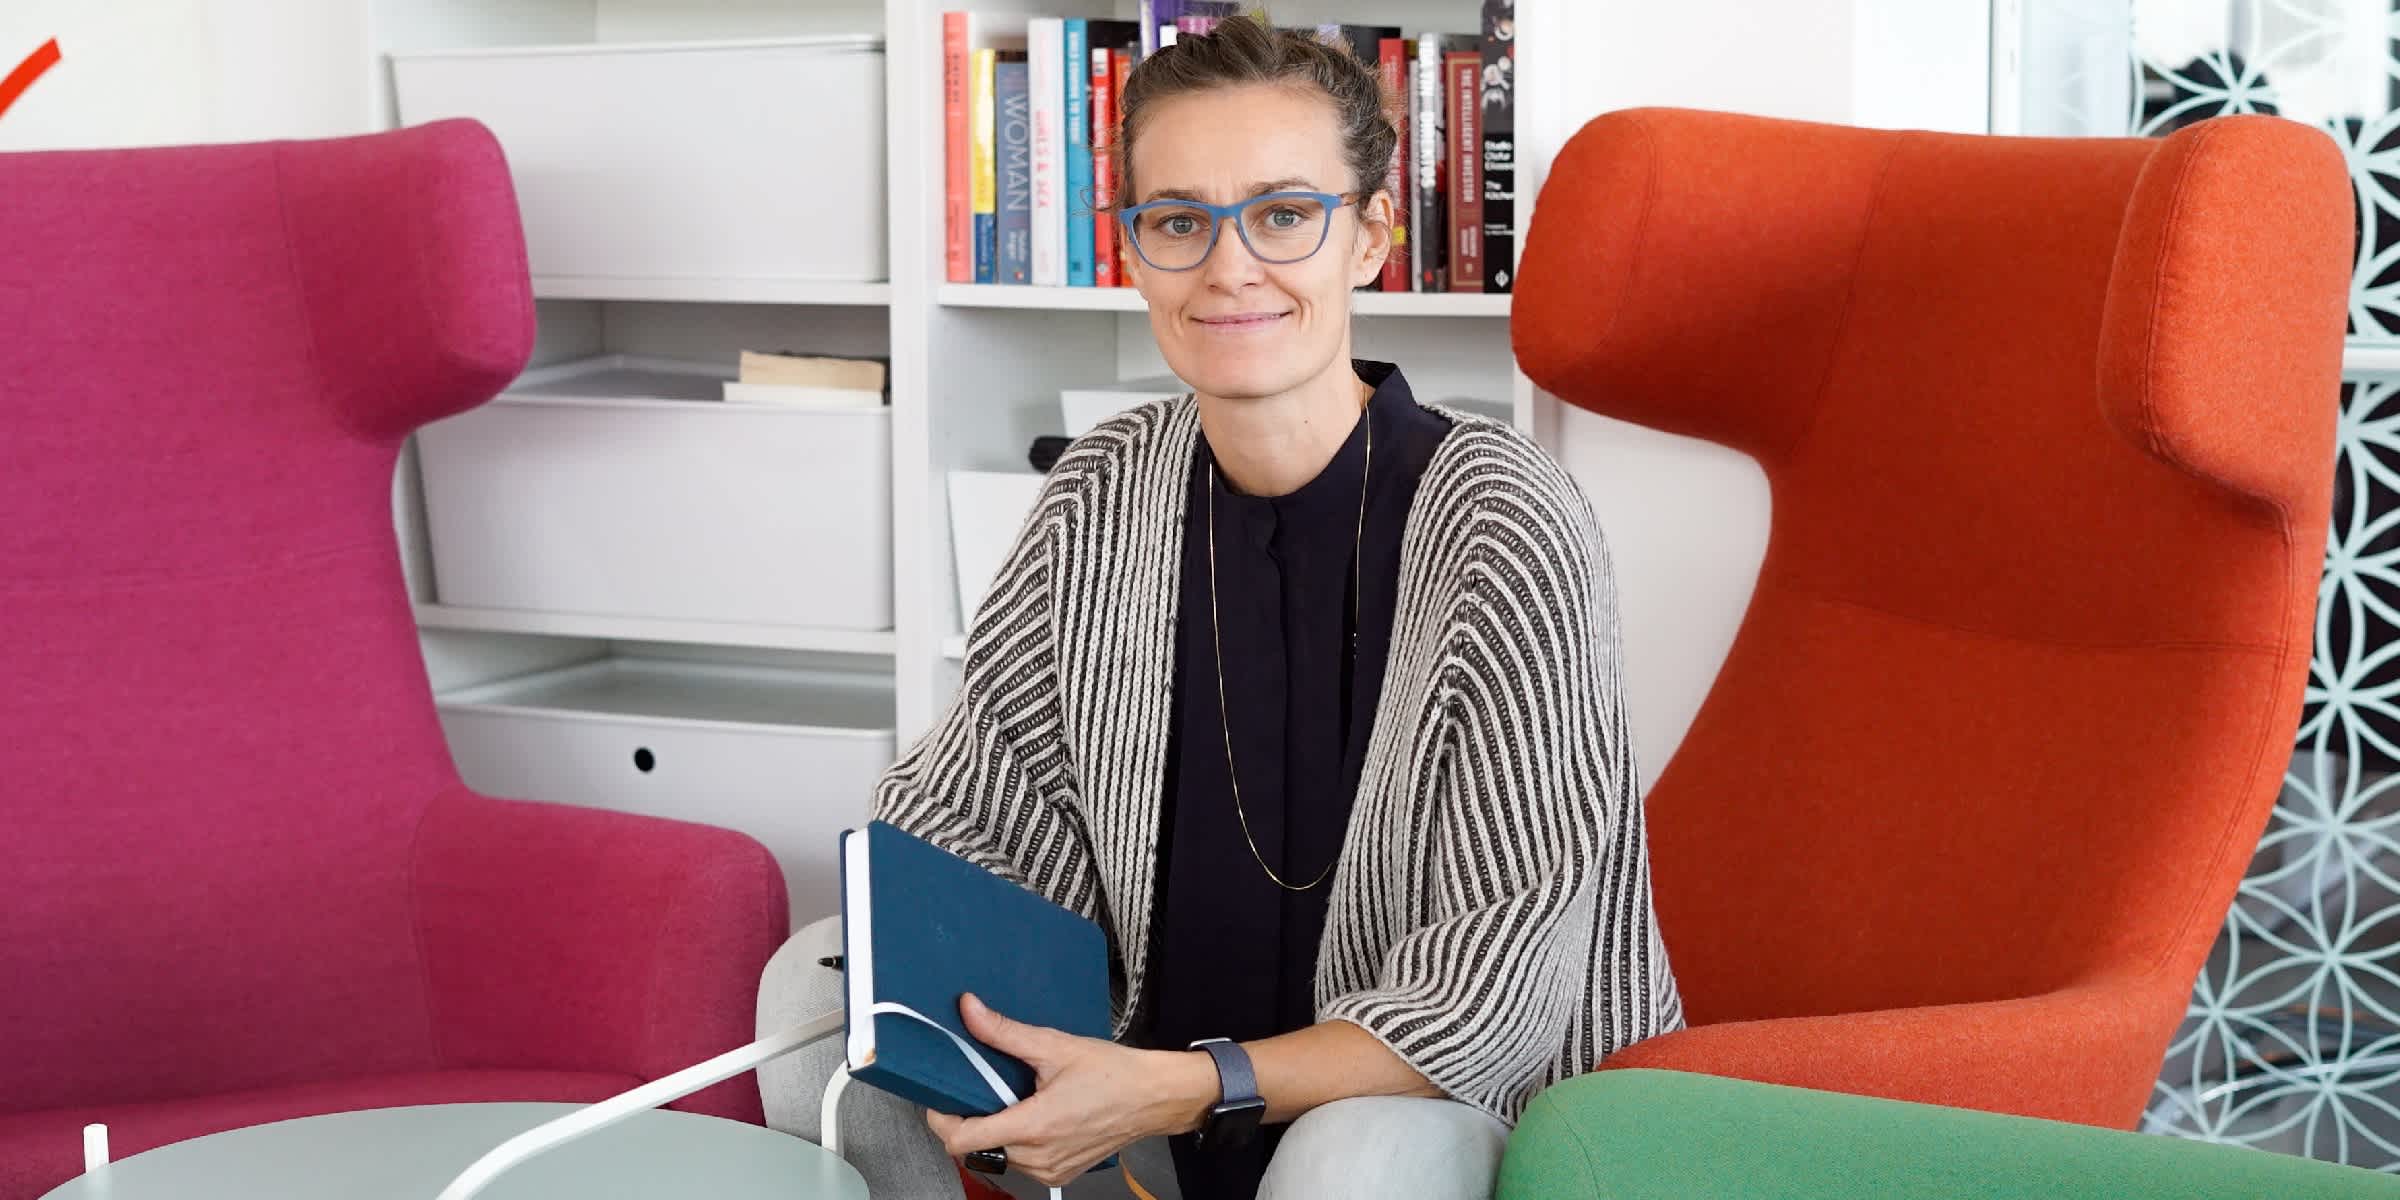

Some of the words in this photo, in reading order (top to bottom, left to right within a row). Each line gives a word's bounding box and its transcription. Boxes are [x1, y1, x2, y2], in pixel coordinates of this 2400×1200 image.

[1461, 68, 1473, 87] THE
[1035, 110, 1049, 156] GIRLS
[1461, 89, 1473, 152] INTELLIGENT
[1004, 92, 1028, 210] WOMAN
[1036, 162, 1049, 173] &
[1036, 179, 1049, 208] SEX
[1462, 153, 1474, 203] INVESTOR
